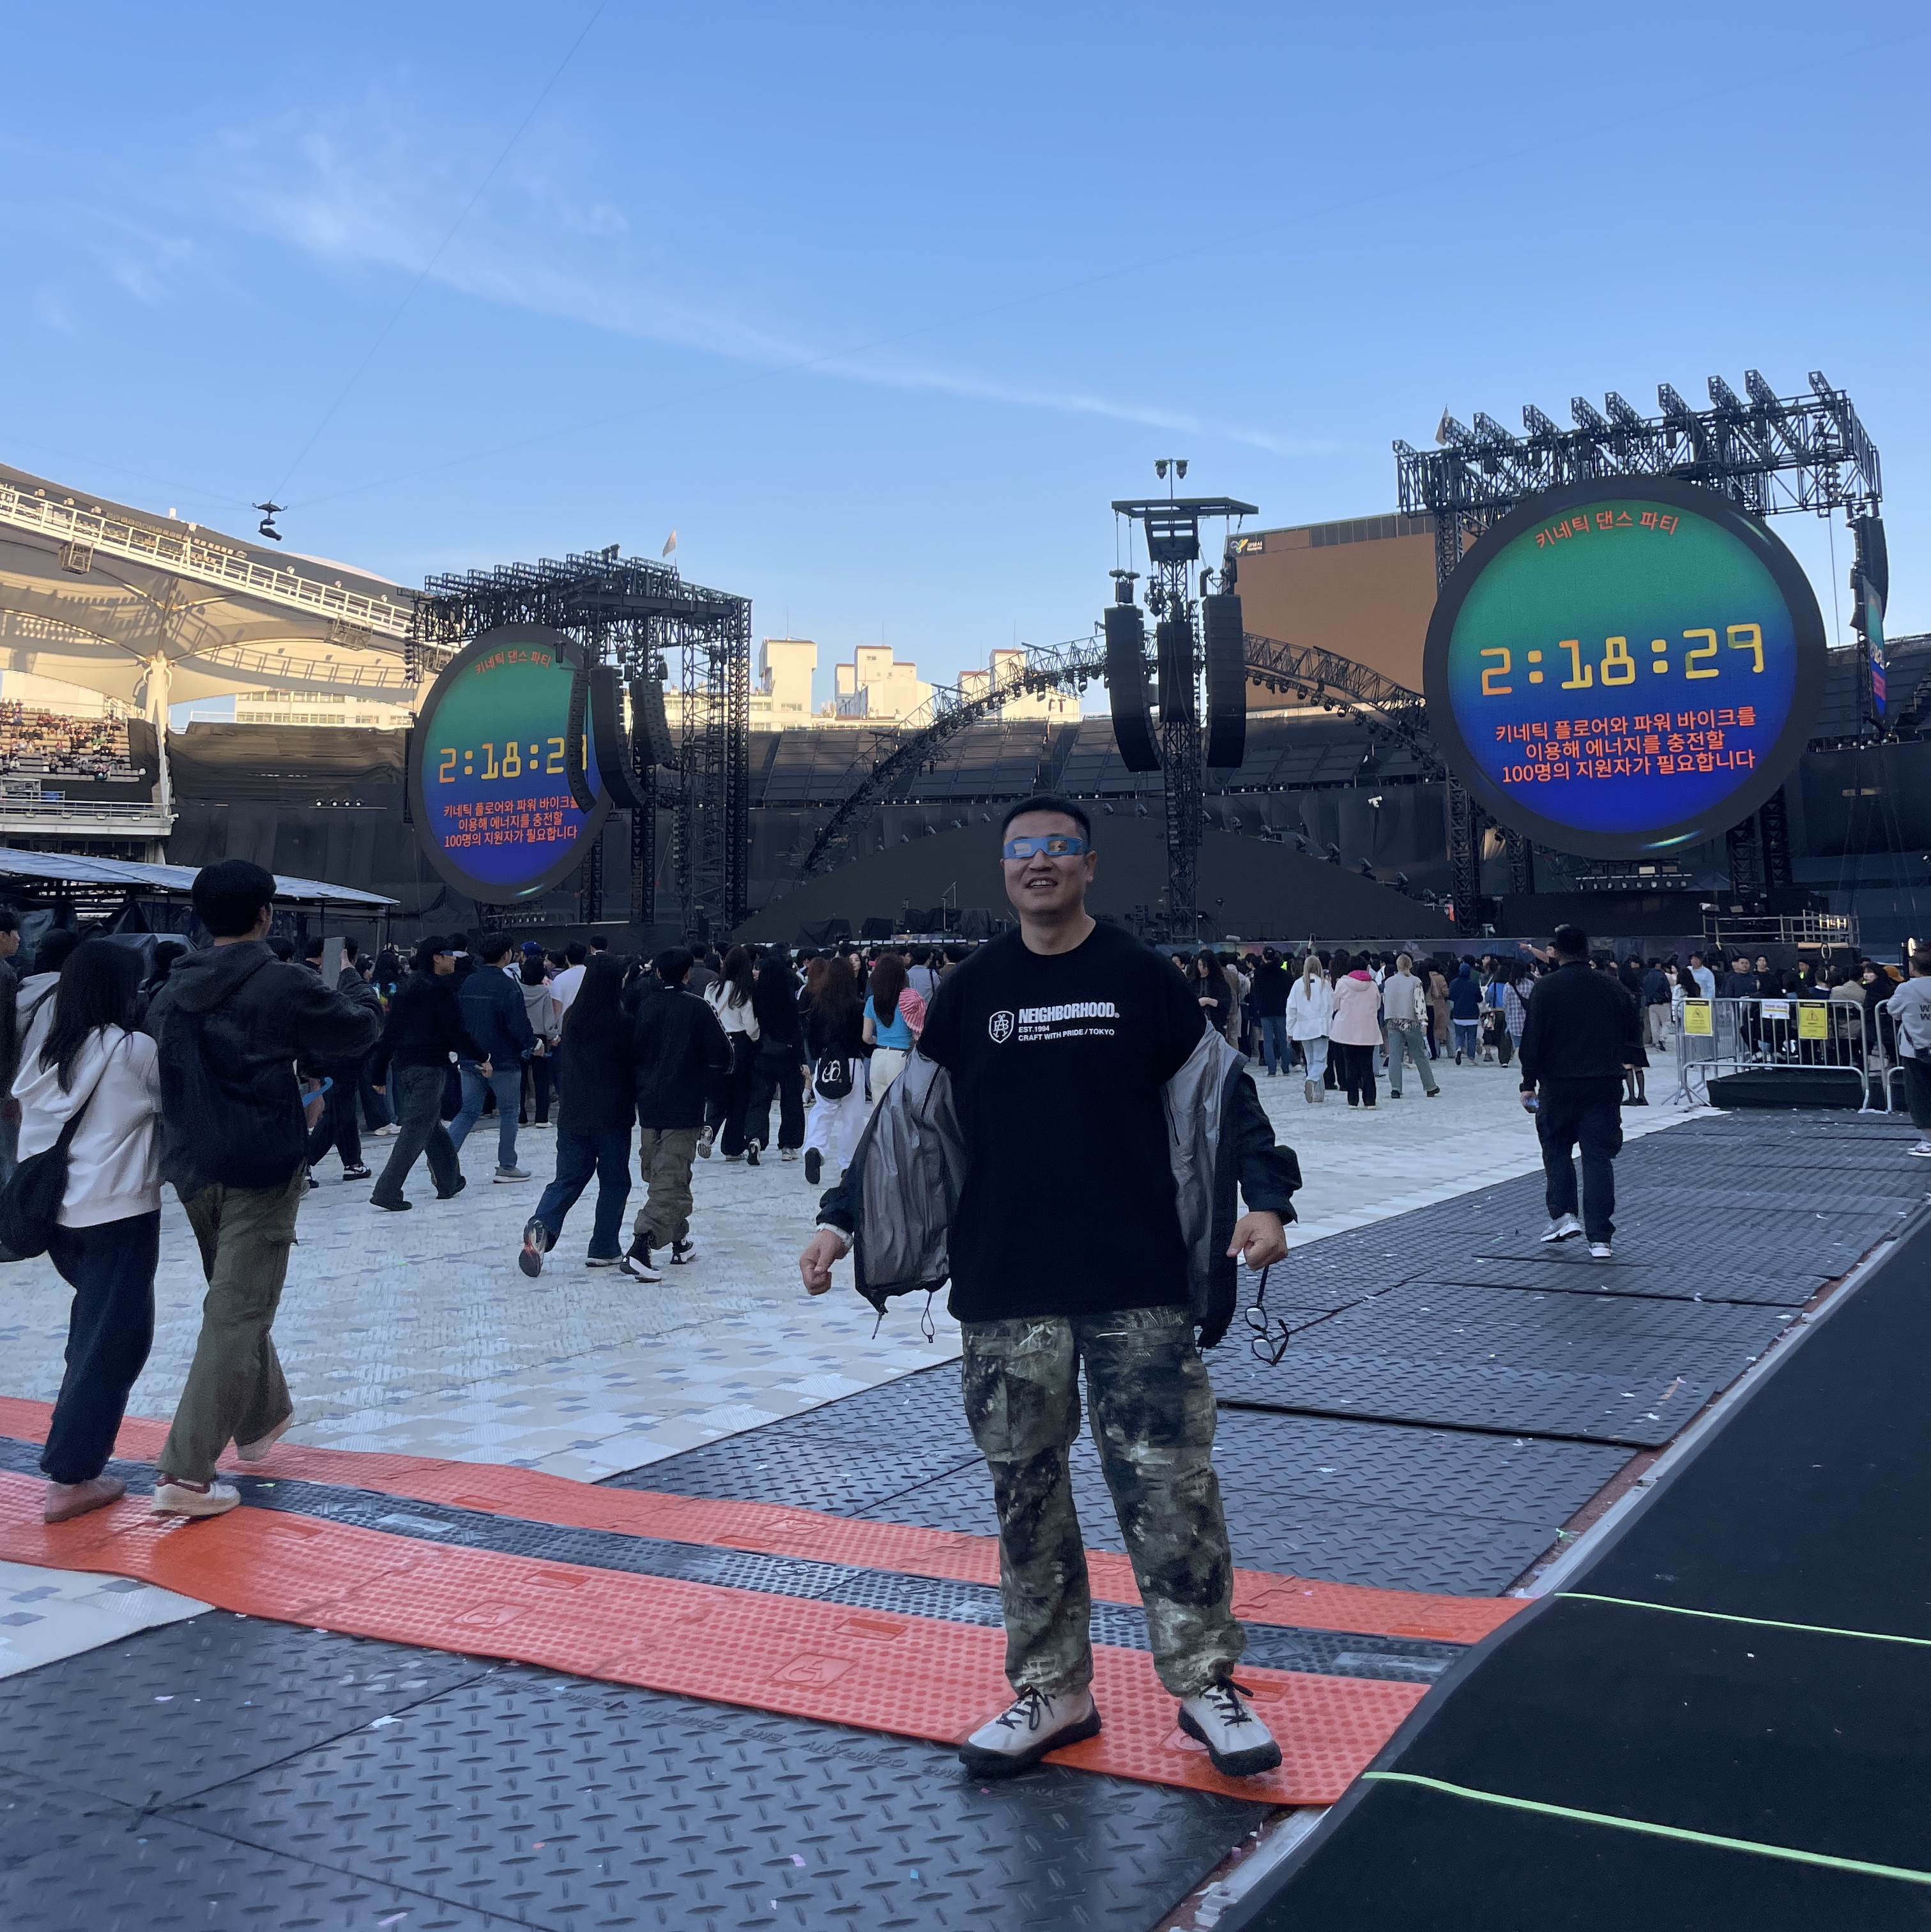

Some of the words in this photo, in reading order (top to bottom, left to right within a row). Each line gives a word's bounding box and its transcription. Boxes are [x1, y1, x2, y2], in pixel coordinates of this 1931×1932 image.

[1535, 514, 1590, 548] 키네틱
[1596, 510, 1633, 530] 댄스
[1640, 512, 1679, 535] 파티
[475, 650, 505, 675] 키네틱
[507, 648, 528, 664] 댄스
[531, 651, 551, 669] 파티
[1480, 622, 1764, 696] 2:18:29
[1495, 721, 1548, 743] 키네틱
[1553, 716, 1629, 740] 플로어와
[1633, 712, 1672, 733] 파워
[1677, 705, 1757, 729] 바이크를
[439, 734, 587, 783] 2:18:2
[1525, 740, 1580, 762] 이용해
[1585, 734, 1661, 758] 에너지를
[1667, 729, 1726, 753] 충전할
[1502, 761, 1570, 783] 100명의
[1575, 756, 1651, 779] 지원자가
[1656, 749, 1757, 775] 필요합니다
[443, 803, 472, 818] 키네틱
[475, 799, 514, 816] 플로어와
[516, 798, 537, 813] 파워
[458, 816, 487, 832] 이용해
[490, 813, 530, 829] 에너지를
[533, 810, 563, 827] 충전할
[444, 832, 481, 848] 100명의
[484, 830, 524, 845] 지원자가
[526, 825, 577, 843] 필요합니다
[1044, 1031, 1062, 1040] WITH
[1062, 1029, 1084, 1038] PRIDE
